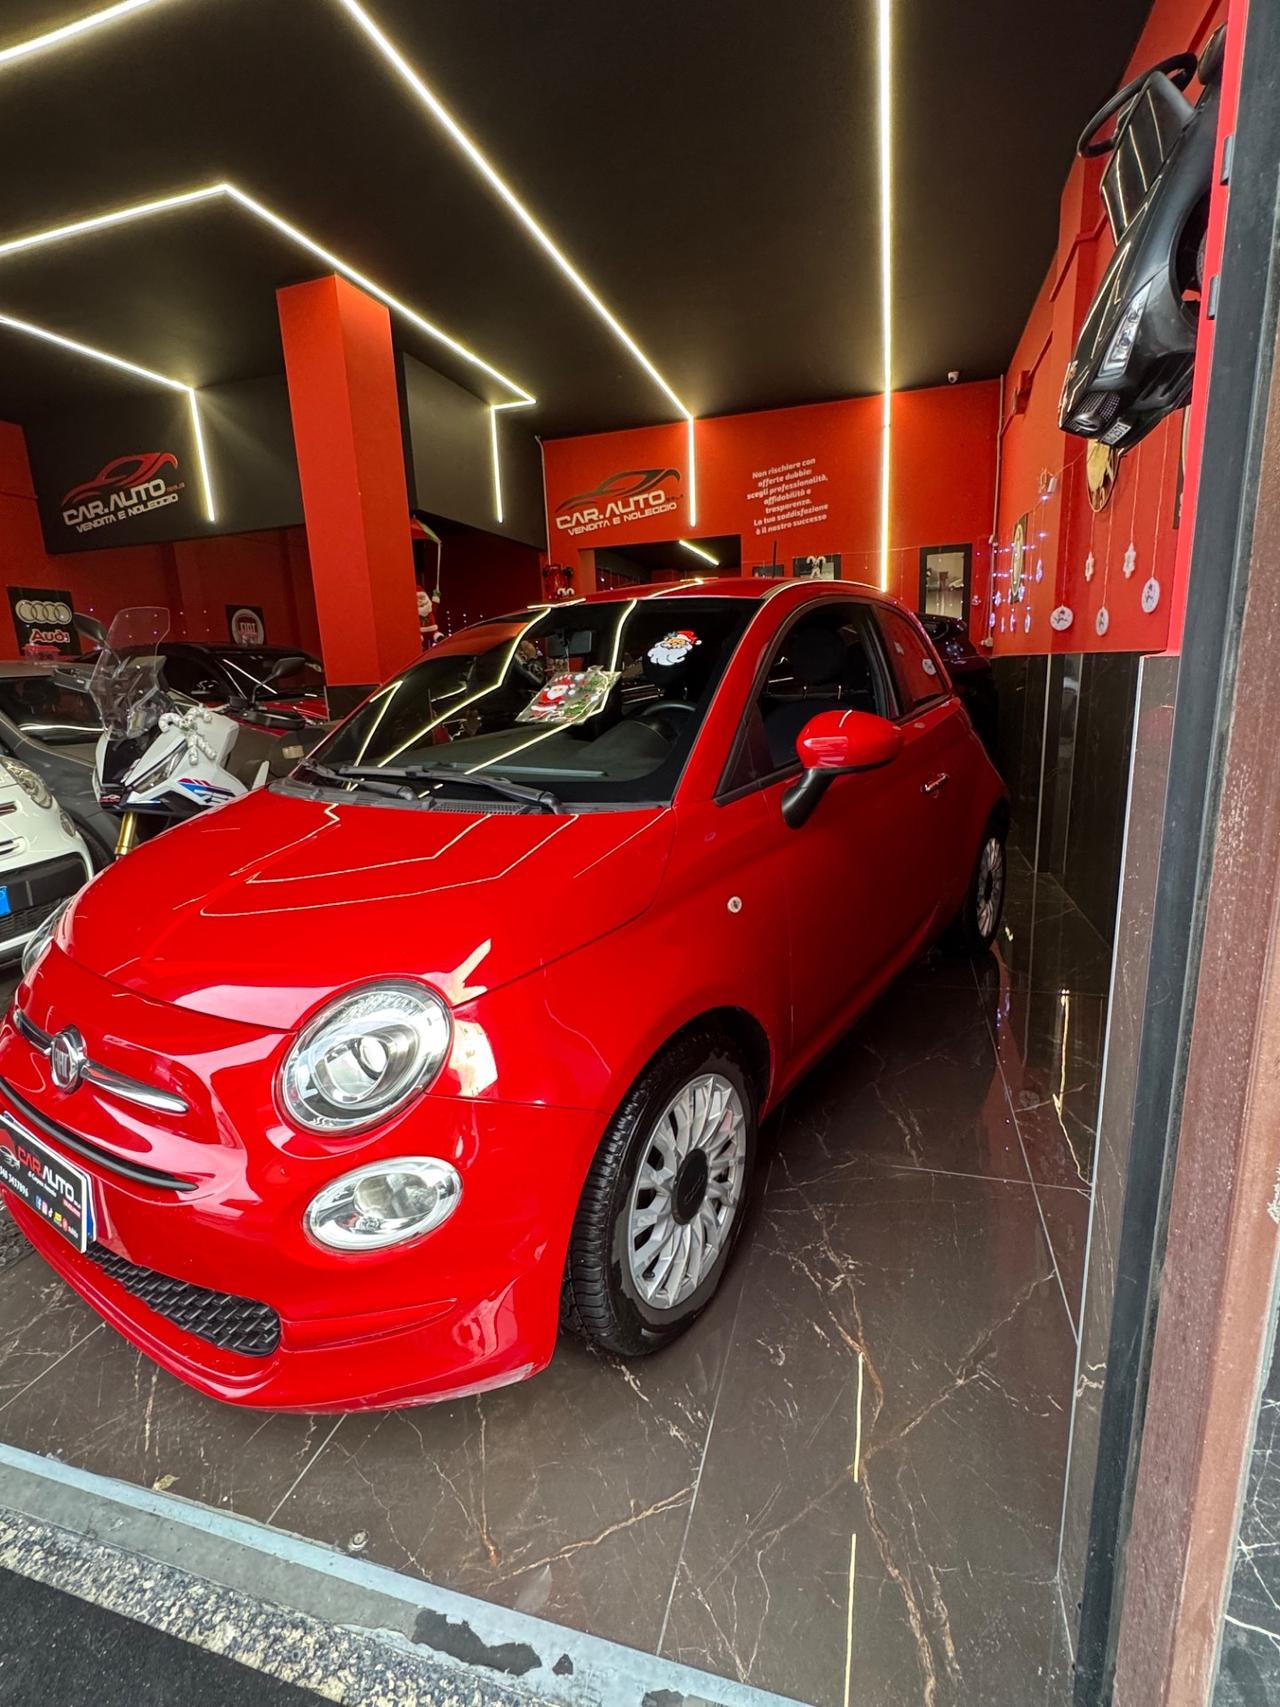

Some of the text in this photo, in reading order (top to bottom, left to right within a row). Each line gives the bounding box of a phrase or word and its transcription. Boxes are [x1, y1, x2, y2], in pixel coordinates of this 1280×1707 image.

[752, 458, 815, 479] Non rischiare con
[758, 476, 784, 487] offerte
[63, 479, 166, 525] CAR.AUTO
[747, 488, 768, 500] scegli
[764, 489, 805, 506] affidabilità
[76, 493, 179, 533] VENDITA E NOLEGGIO
[556, 490, 666, 529] CAR.AUTO
[568, 519, 611, 536] VENDITA
[623, 502, 677, 523] NOLEGGIO
[753, 504, 829, 527] La tua soddisfazione
[768, 522, 792, 533] nostro
[793, 514, 827, 526] successo
[30, 629, 70, 643] Audi
